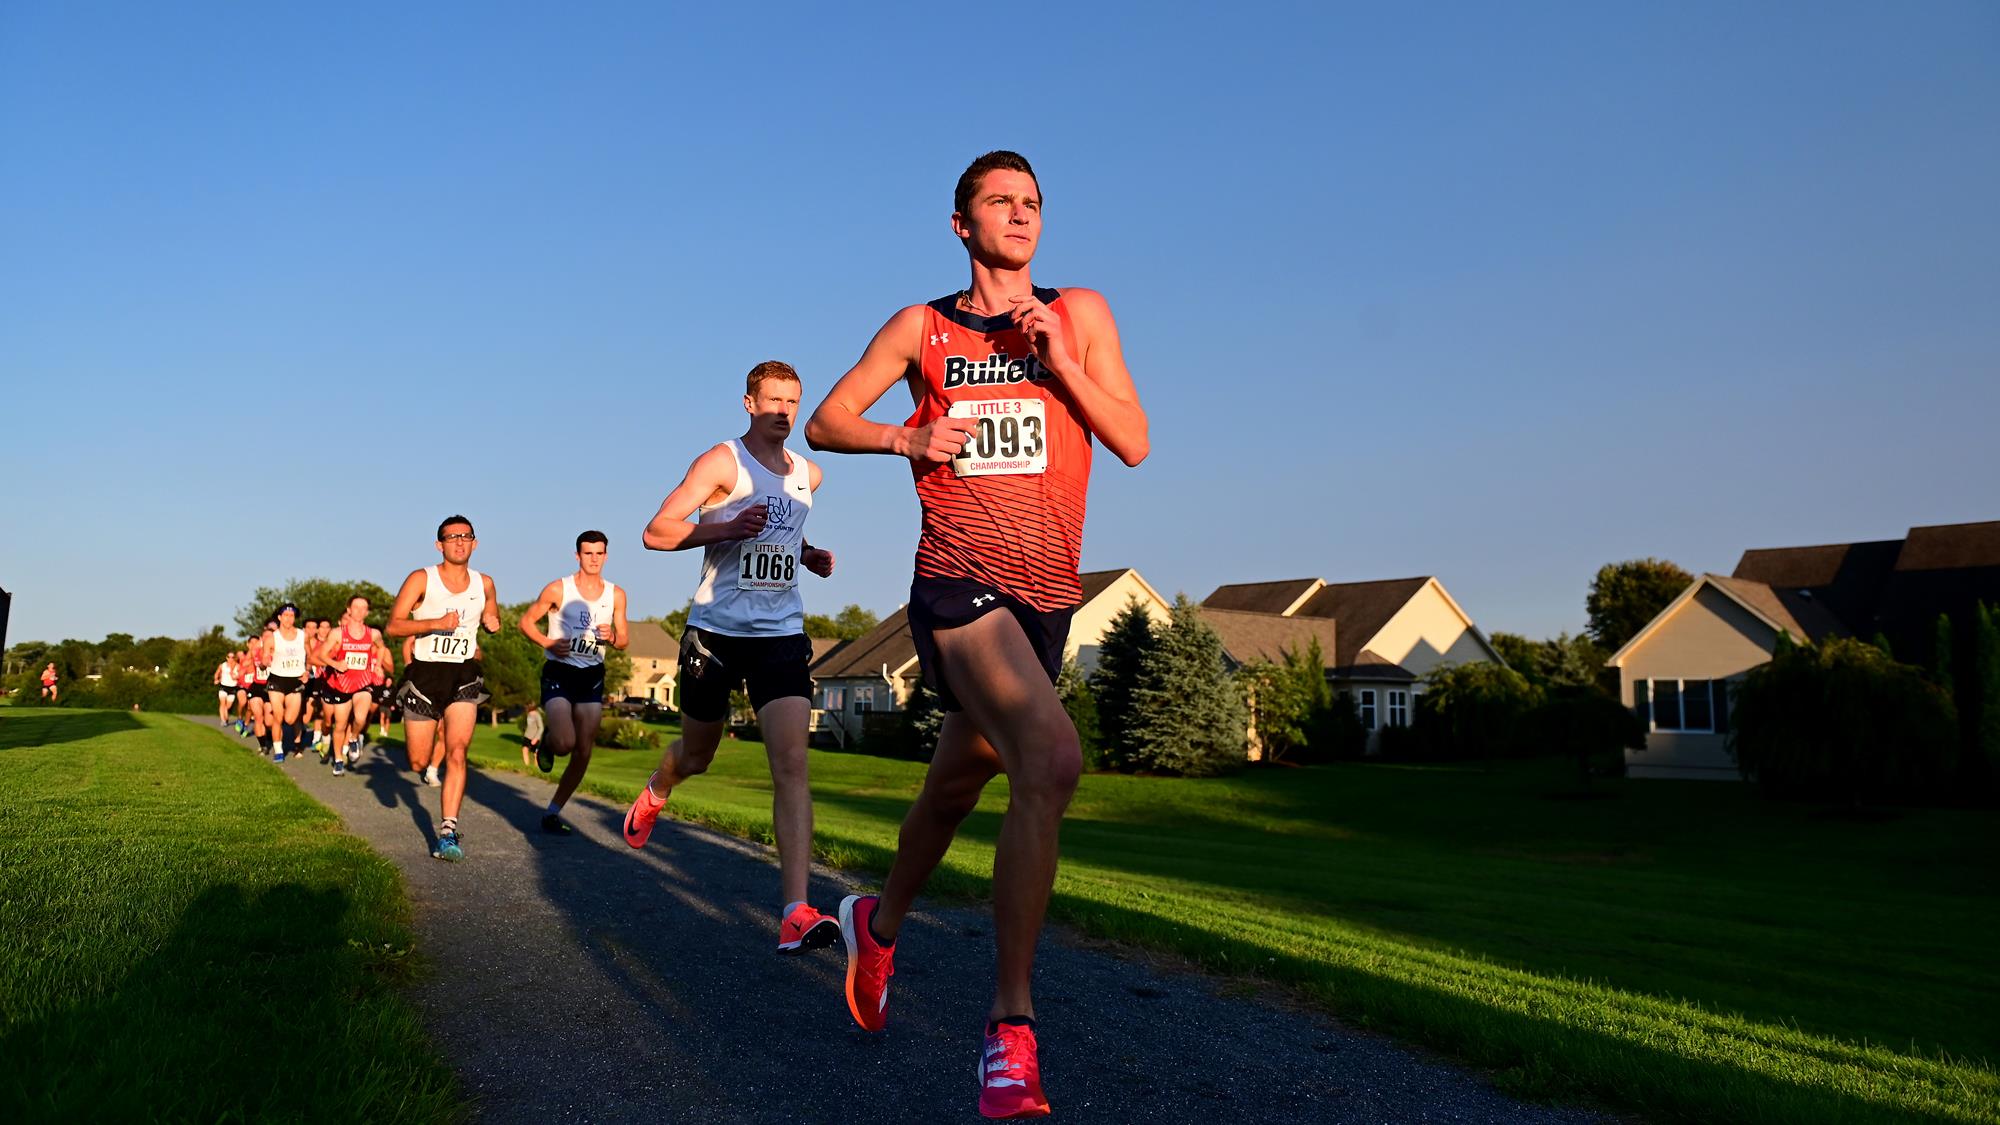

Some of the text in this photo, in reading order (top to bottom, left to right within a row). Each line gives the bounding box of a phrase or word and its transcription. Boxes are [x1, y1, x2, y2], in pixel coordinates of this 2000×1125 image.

[970, 402, 1022, 415] LITTLE 3
[970, 461, 1031, 470] CHAMPIONSHIP
[755, 544, 779, 552] LITTLE
[742, 553, 794, 581] 1068
[432, 637, 469, 656] 1073
